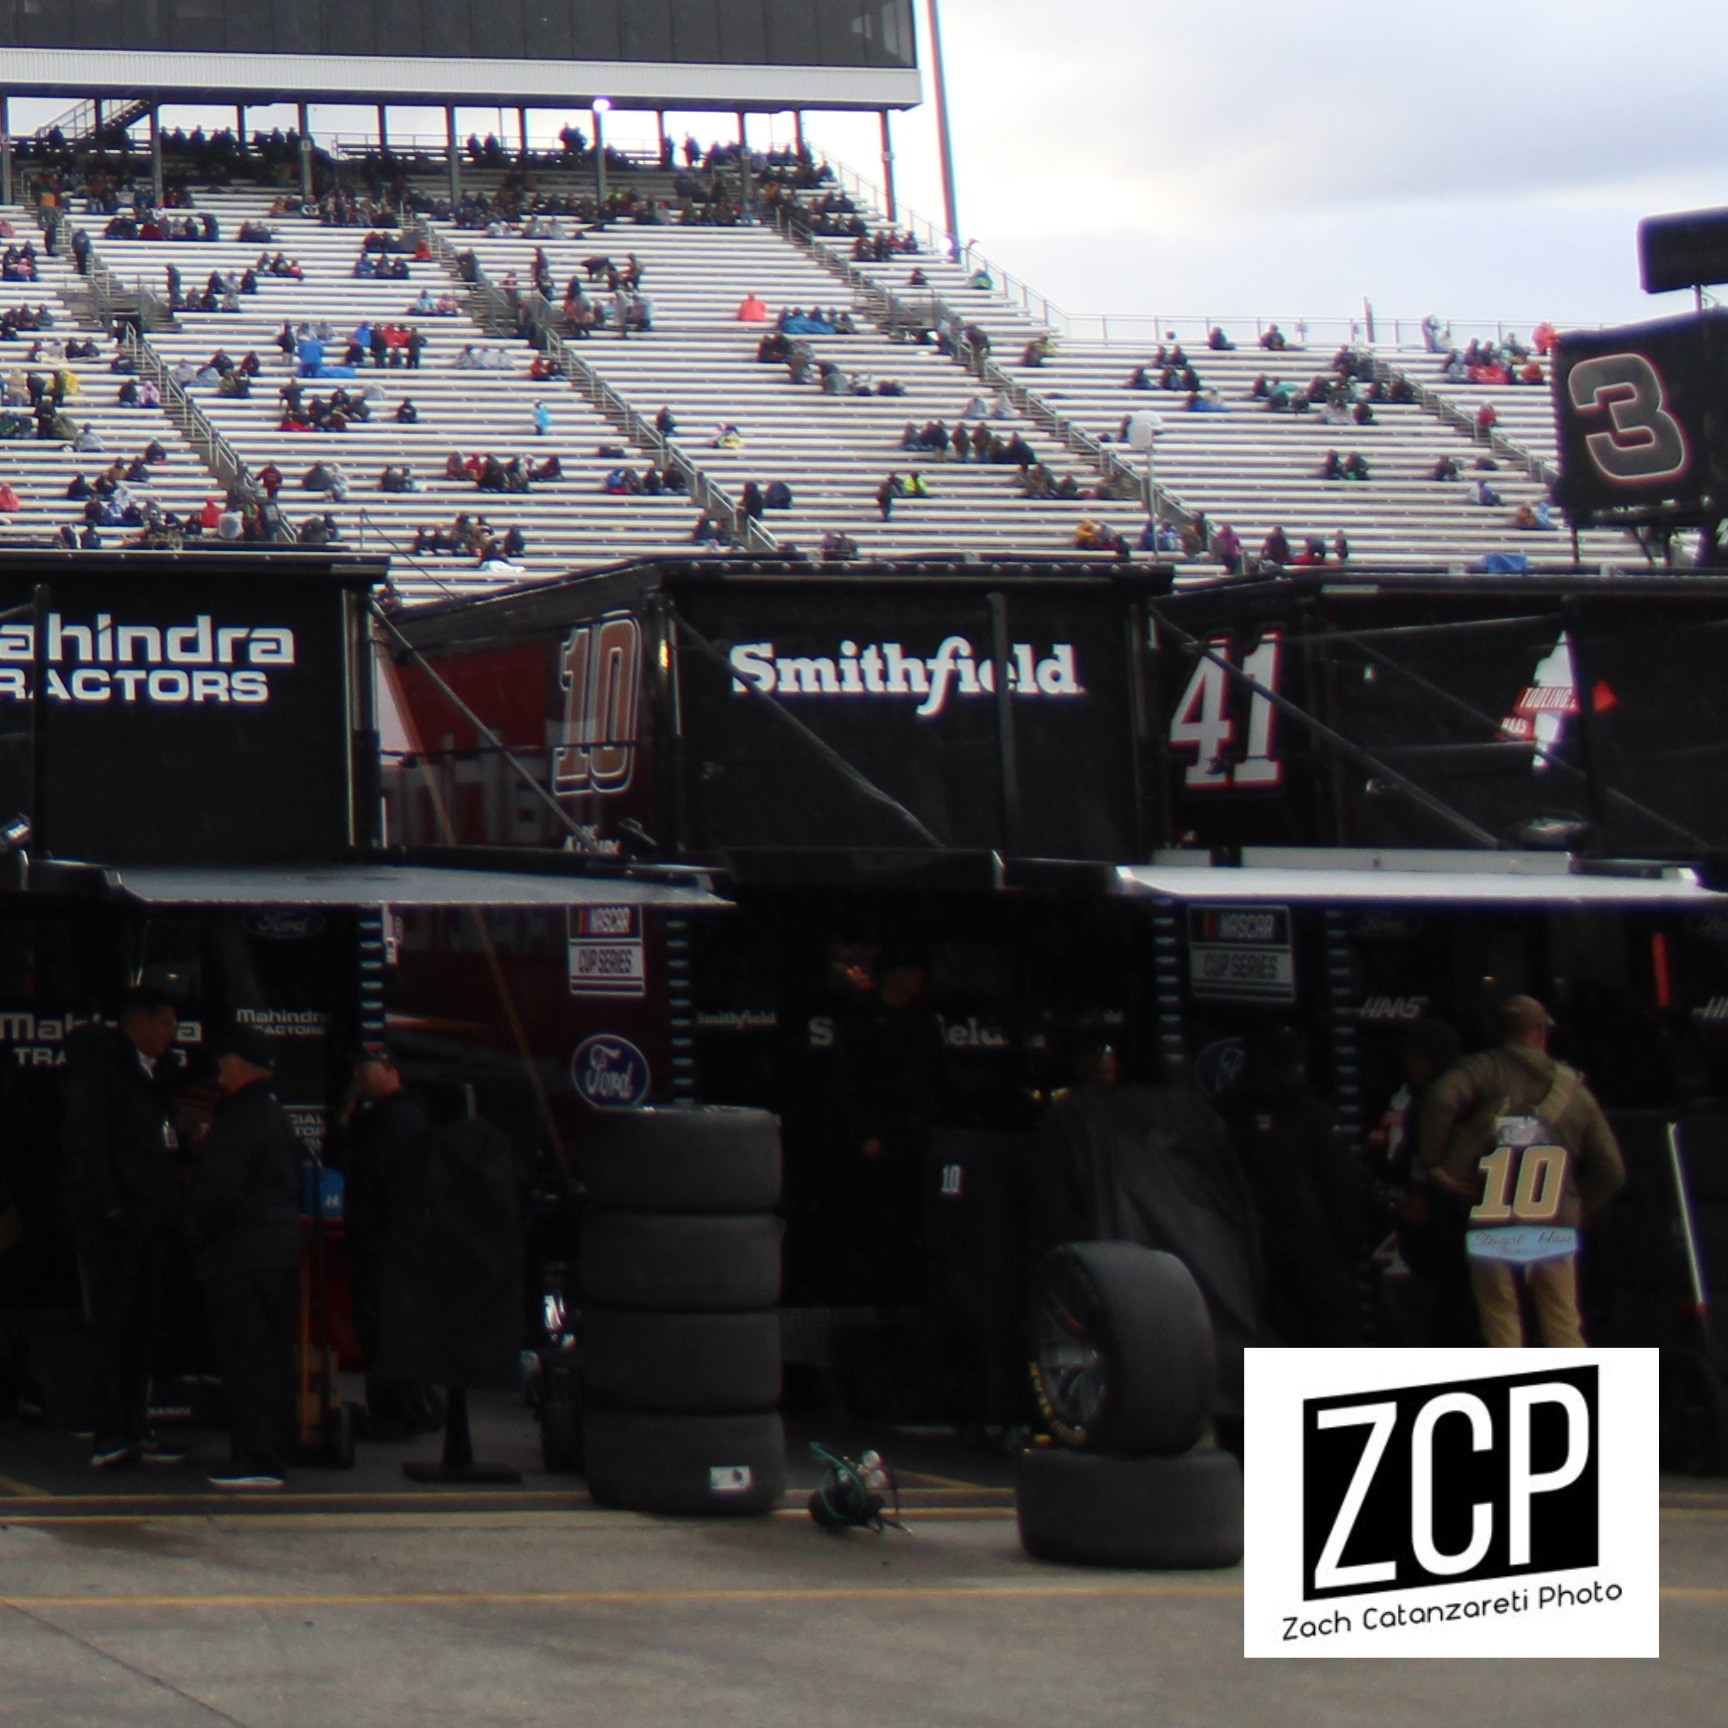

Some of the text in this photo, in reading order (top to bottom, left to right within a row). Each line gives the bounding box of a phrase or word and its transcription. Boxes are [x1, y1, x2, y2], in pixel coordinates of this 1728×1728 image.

[1568, 353, 1686, 481] 3
[552, 610, 643, 797] 10
[731, 636, 1078, 716] Smithfield
[1170, 630, 1284, 790] 41
[589, 907, 631, 934] NASCAR
[1218, 912, 1275, 940] NASCAR
[578, 949, 633, 974] CUP SERIES
[1204, 953, 1278, 980] CUP SERIES
[584, 1044, 634, 1103] Ford
[940, 1163, 963, 1196] 10
[1469, 1145, 1568, 1219] 10
